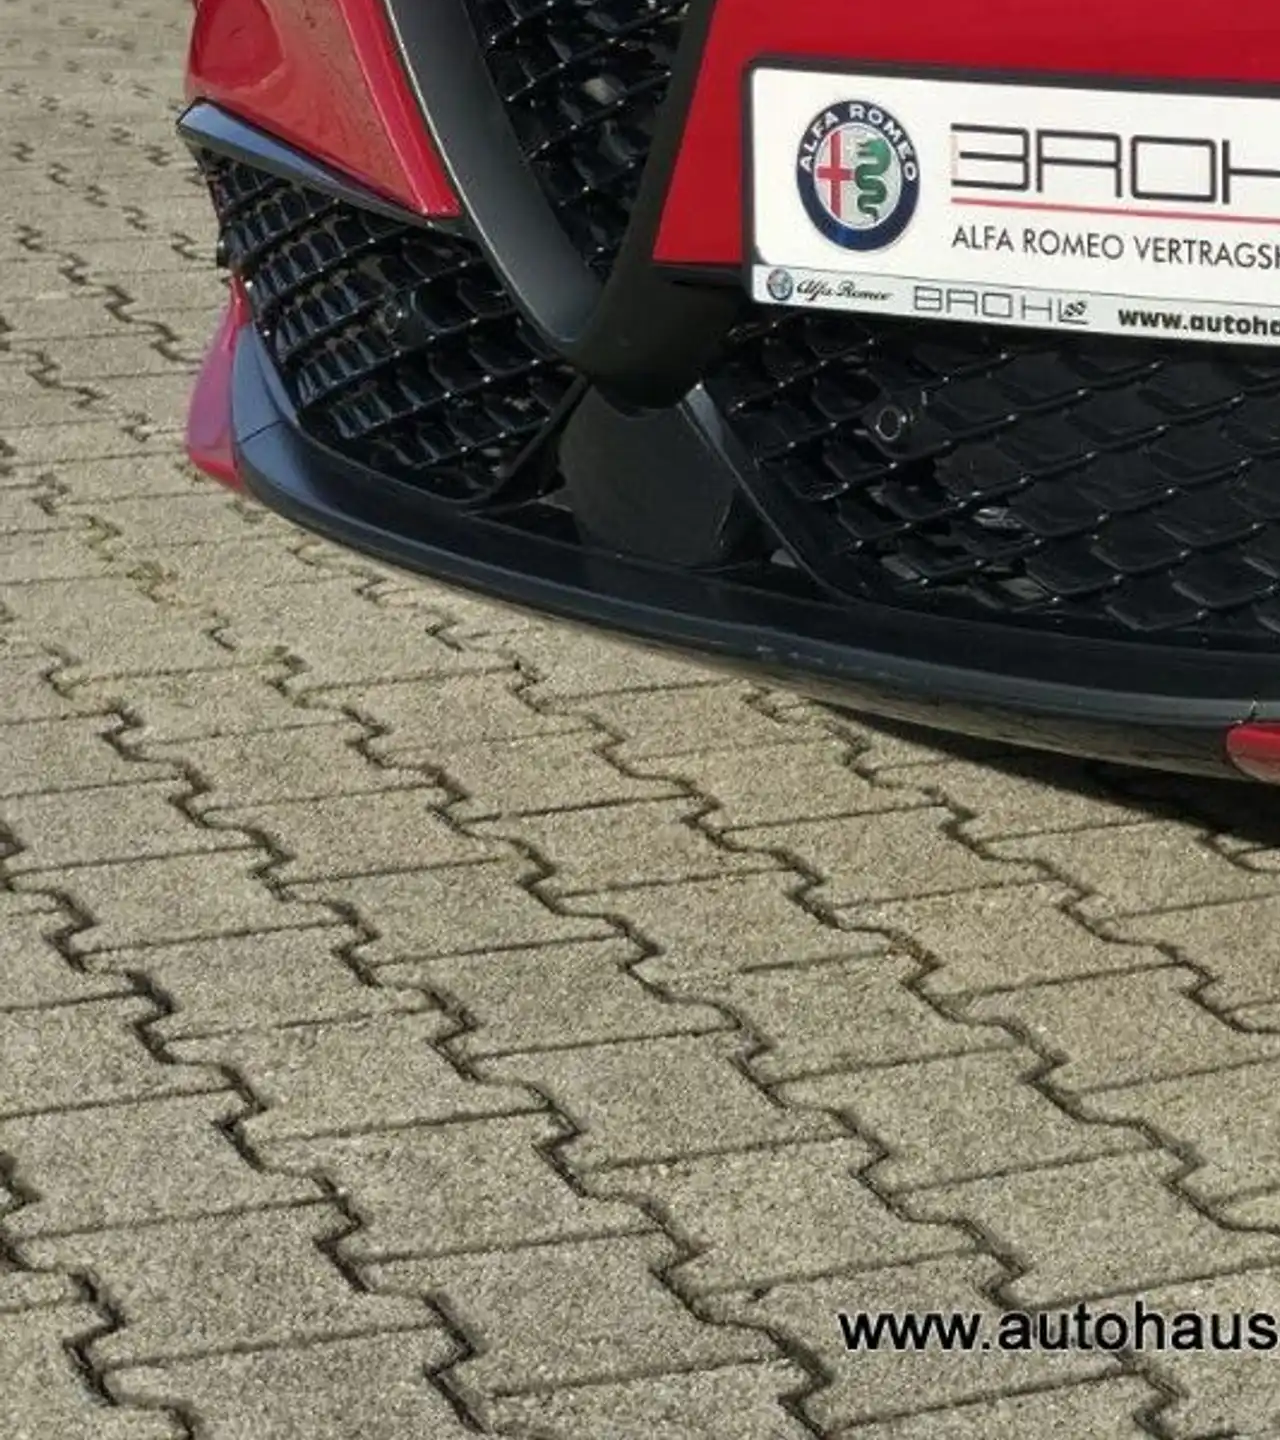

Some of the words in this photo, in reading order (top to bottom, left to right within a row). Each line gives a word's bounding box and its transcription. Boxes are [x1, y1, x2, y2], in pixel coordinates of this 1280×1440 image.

[800, 111, 840, 173] ALFA
[849, 103, 917, 181] ROMEO
[952, 225, 1014, 253] ALFA
[1023, 230, 1125, 259] ROMEO
[796, 279, 832, 302] Alfa
[914, 285, 1089, 325] BROHL
